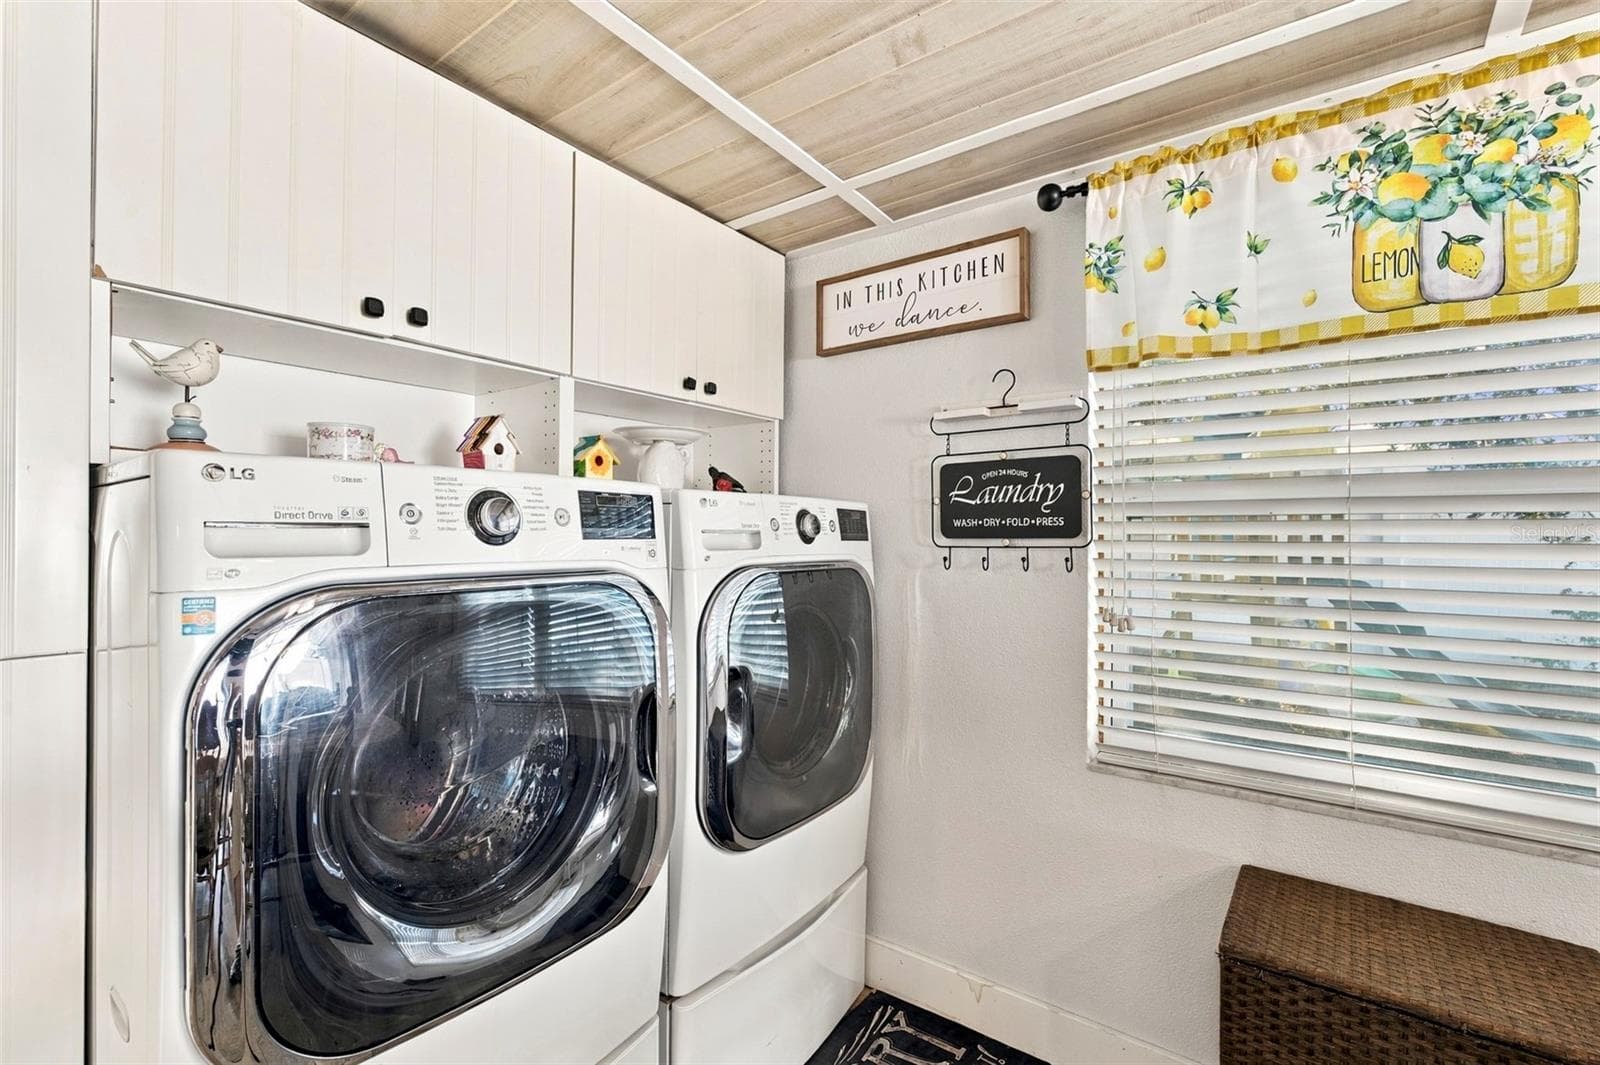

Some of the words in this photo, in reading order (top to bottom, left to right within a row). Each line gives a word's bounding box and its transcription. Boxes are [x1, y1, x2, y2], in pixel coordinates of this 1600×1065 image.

[836, 290, 852, 311] IN
[864, 278, 904, 304] THIS
[918, 252, 1005, 292] KITCHEN
[848, 320, 885, 338] we
[895, 291, 983, 328] dance.
[230, 467, 256, 481] LG
[981, 470, 998, 480] OPEN
[1007, 469, 1029, 478] HOURS
[949, 472, 1065, 513] Laundry
[274, 511, 306, 520] Direct
[307, 511, 334, 520] Drive
[952, 518, 978, 527] WASH
[983, 518, 1001, 527] DRY
[1006, 517, 1031, 527] FOLD
[1036, 516, 1065, 526] PRESS
